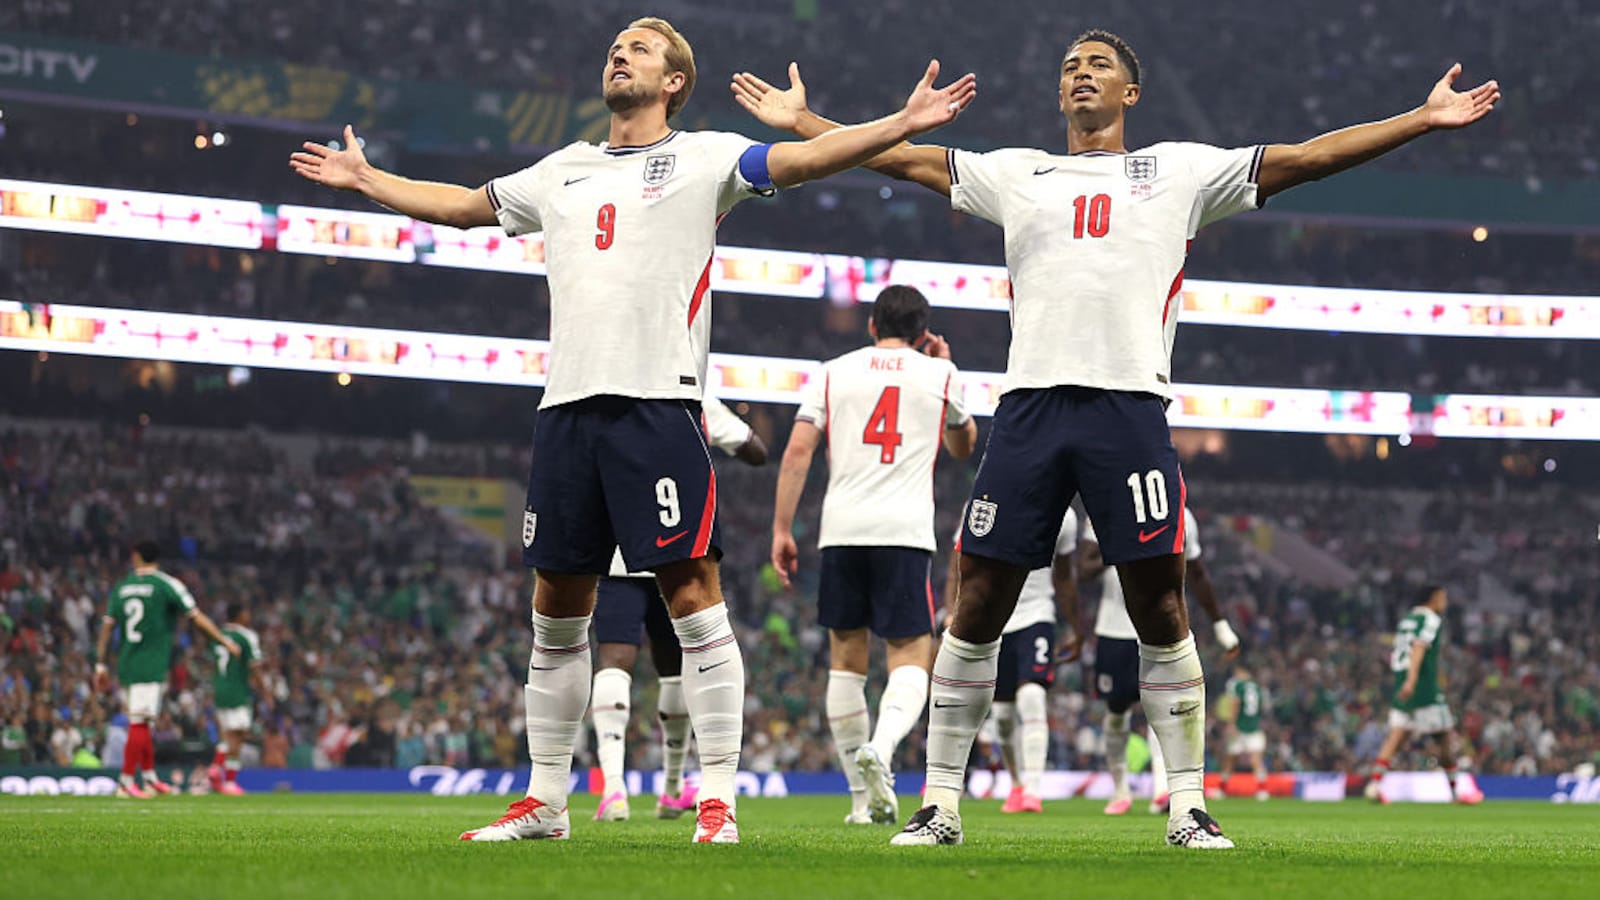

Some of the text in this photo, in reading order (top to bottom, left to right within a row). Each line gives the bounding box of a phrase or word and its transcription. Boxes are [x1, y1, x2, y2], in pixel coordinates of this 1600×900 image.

[595, 203, 616, 251] 9
[1072, 194, 1112, 239] 10
[870, 356, 904, 371] RICE
[862, 386, 902, 464] 4
[655, 477, 681, 528] 9
[1127, 470, 1169, 523] 10
[124, 598, 144, 643] 2
[1034, 636, 1049, 664] 2
